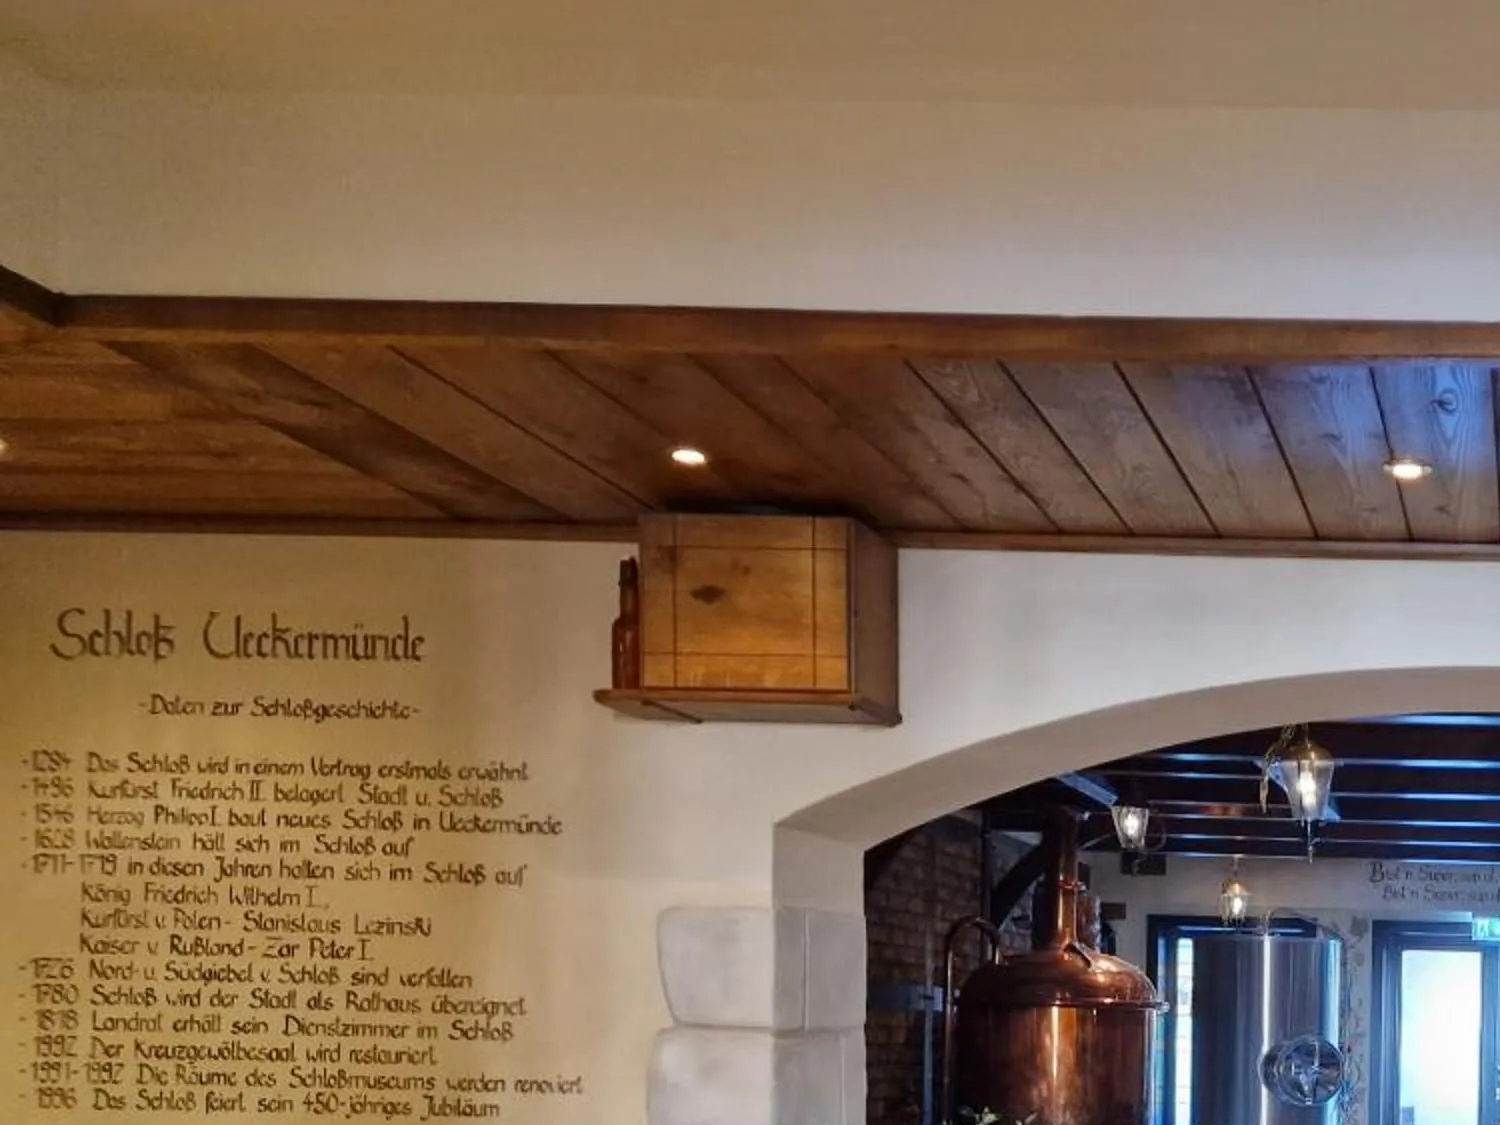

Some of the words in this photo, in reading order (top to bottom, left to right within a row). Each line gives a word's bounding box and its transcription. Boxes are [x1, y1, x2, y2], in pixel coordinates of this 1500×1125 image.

[50, 607, 175, 662] Schloß
[203, 611, 425, 662] Ueckermünde
[211, 699, 242, 717] zur
[86, 751, 119, 774] Das
[126, 751, 188, 775] Schloß
[197, 756, 229, 775] wird
[234, 758, 250, 775] in
[252, 758, 304, 777] einem
[309, 756, 371, 782] Vertrag
[377, 760, 451, 781] erstmals
[457, 762, 529, 781] erwähnt
[88, 780, 159, 800] Kurfürst
[170, 777, 246, 801] Friedrich
[273, 782, 344, 806] belagert
[357, 783, 408, 806] Stadt
[438, 784, 504, 810] Schloß
[87, 808, 146, 830] Herzog
[153, 803, 208, 826] Philipp
[227, 807, 267, 828] baut
[275, 811, 331, 830] neues
[342, 808, 404, 834] Schloß
[412, 814, 431, 832] in
[438, 811, 563, 836] Ueckermünde
[85, 828, 181, 852] Wallenstein
[192, 832, 225, 852] hält
[234, 833, 270, 854] sich
[279, 836, 301, 854] im
[314, 833, 377, 856] Schloß
[381, 837, 415, 858] auf
[126, 858, 143, 876] in
[148, 856, 205, 878] diesen
[212, 855, 272, 883] Jahren
[343, 861, 381, 881] sich
[388, 864, 413, 882] im
[423, 861, 488, 886] Schloß
[495, 864, 528, 888] auf
[81, 883, 131, 910] König
[144, 881, 219, 904] Friedrich
[228, 884, 301, 907] Wilhelm
[81, 906, 150, 930] Kurfürst
[243, 909, 342, 934] Stanislaus
[79, 932, 140, 955] Kaiser
[261, 936, 301, 959] Zar
[308, 937, 355, 960] Peter
[164, 959, 253, 986] Südgiebel
[277, 962, 341, 987] Schloß
[350, 966, 389, 987] sind
[399, 966, 473, 990] verfallen
[90, 983, 157, 1007] Schloß
[165, 987, 201, 1008] wird
[209, 988, 239, 1008] der
[249, 986, 297, 1010] Stadt
[307, 990, 334, 1012] als
[345, 990, 422, 1014] Rathaus
[431, 994, 527, 1020] übereignet
[91, 1010, 162, 1032] Landrat
[172, 1012, 221, 1034] erhält
[230, 1015, 269, 1036] sein
[283, 1013, 411, 1041] Dienstzimmer
[417, 1020, 438, 1038] im
[448, 1018, 514, 1043] Schloß
[90, 1034, 125, 1059] Der
[134, 1037, 297, 1063] Kreuzgewölbesaal
[305, 1042, 342, 1064] wird
[349, 1044, 437, 1067] restauriert
[135, 1062, 169, 1086] Die
[175, 1062, 238, 1087] Räume
[244, 1067, 277, 1088] des
[289, 1063, 437, 1092] Schloßmuseums
[445, 1071, 506, 1094] werden
[513, 1073, 584, 1097] renoviert
[92, 1086, 127, 1111] Das
[135, 1087, 197, 1112] Schloß
[204, 1090, 247, 1115] feiert
[257, 1093, 293, 1113] sein
[302, 1091, 412, 1121] 450-jähriges
[419, 1094, 500, 1122] Jubiläum
